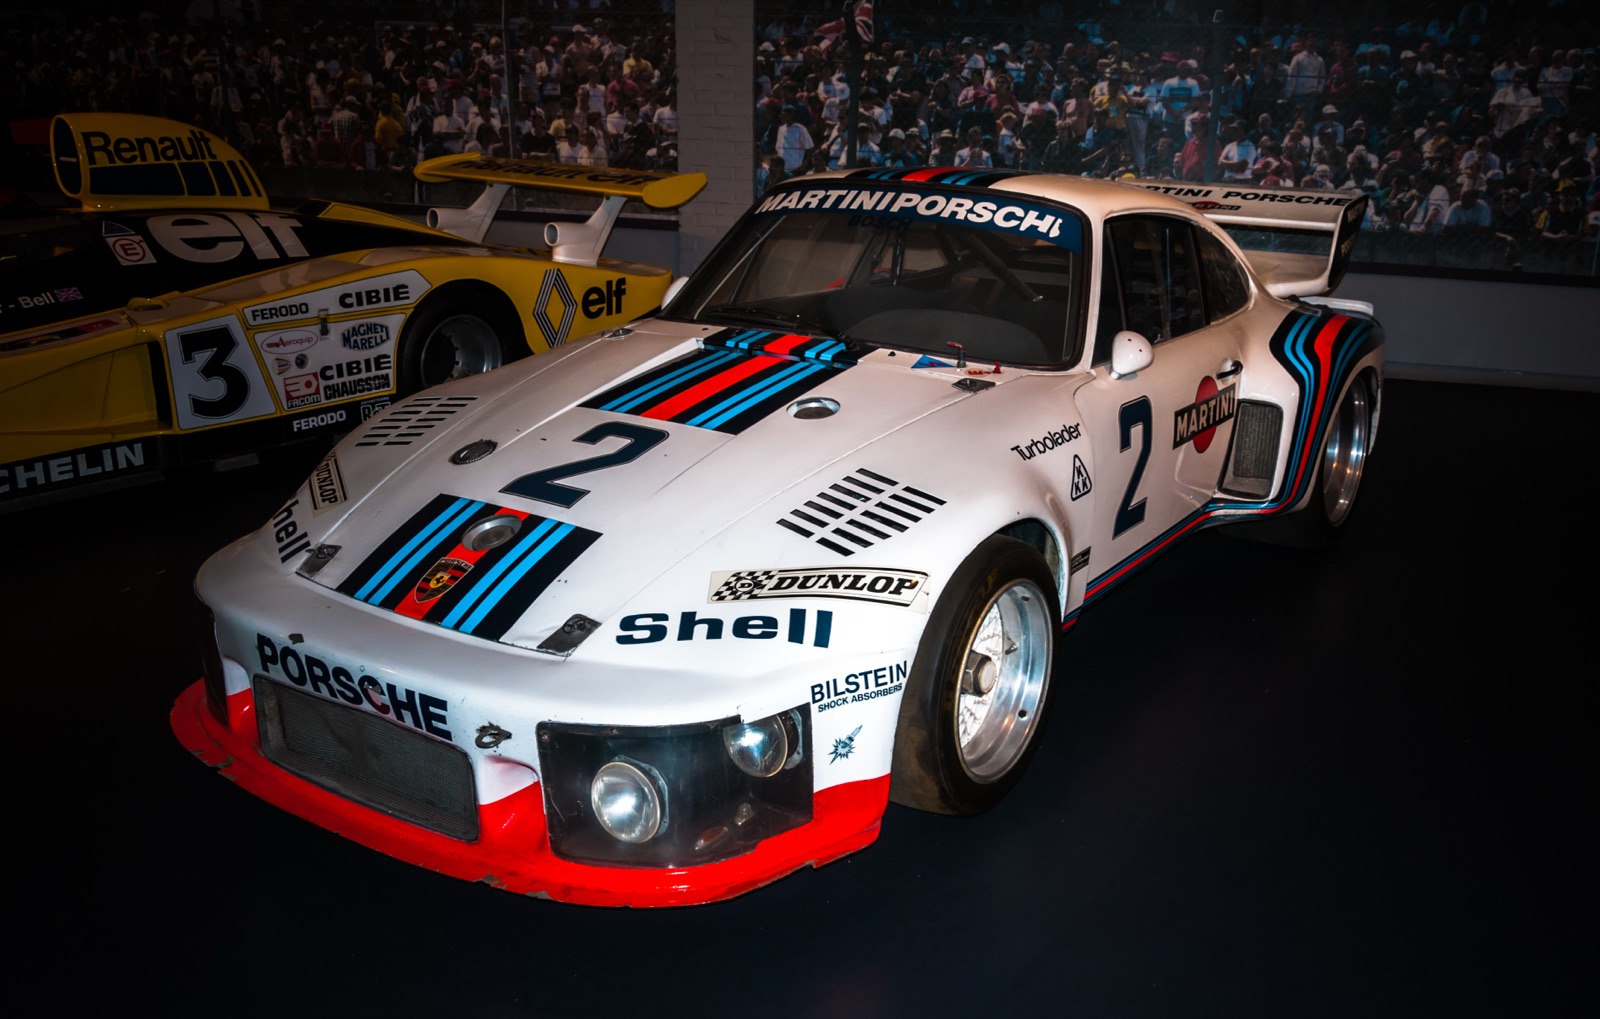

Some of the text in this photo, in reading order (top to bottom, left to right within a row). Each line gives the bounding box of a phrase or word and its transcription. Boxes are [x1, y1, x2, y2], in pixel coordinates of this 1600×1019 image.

[81, 130, 217, 165] Renault
[1222, 191, 1353, 206] PORSCHE
[146, 212, 310, 264] elf
[848, 215, 912, 231] BOSCH
[17, 291, 55, 309] Bell
[251, 302, 309, 321] FERODO
[582, 278, 626, 319] elf
[277, 335, 313, 347] Aeroquip
[342, 322, 389, 345] MAGNETI
[177, 325, 250, 419] 3
[323, 373, 390, 400] CHAUSSON
[287, 394, 321, 409] FACOM
[1175, 390, 1234, 442] MARTINI
[292, 410, 346, 432] FERODO
[1010, 422, 1081, 461] Turbolader
[315, 462, 339, 504] DUNLOP
[498, 421, 670, 509] 2
[1112, 395, 1152, 541] 2
[272, 498, 312, 564] hell
[768, 573, 919, 597] DUNLOP
[616, 608, 833, 648] Shell
[257, 633, 453, 741] PORSCHE
[810, 661, 907, 704] BILSTEIN
[817, 683, 903, 713] SHOCK ABSORBERS
